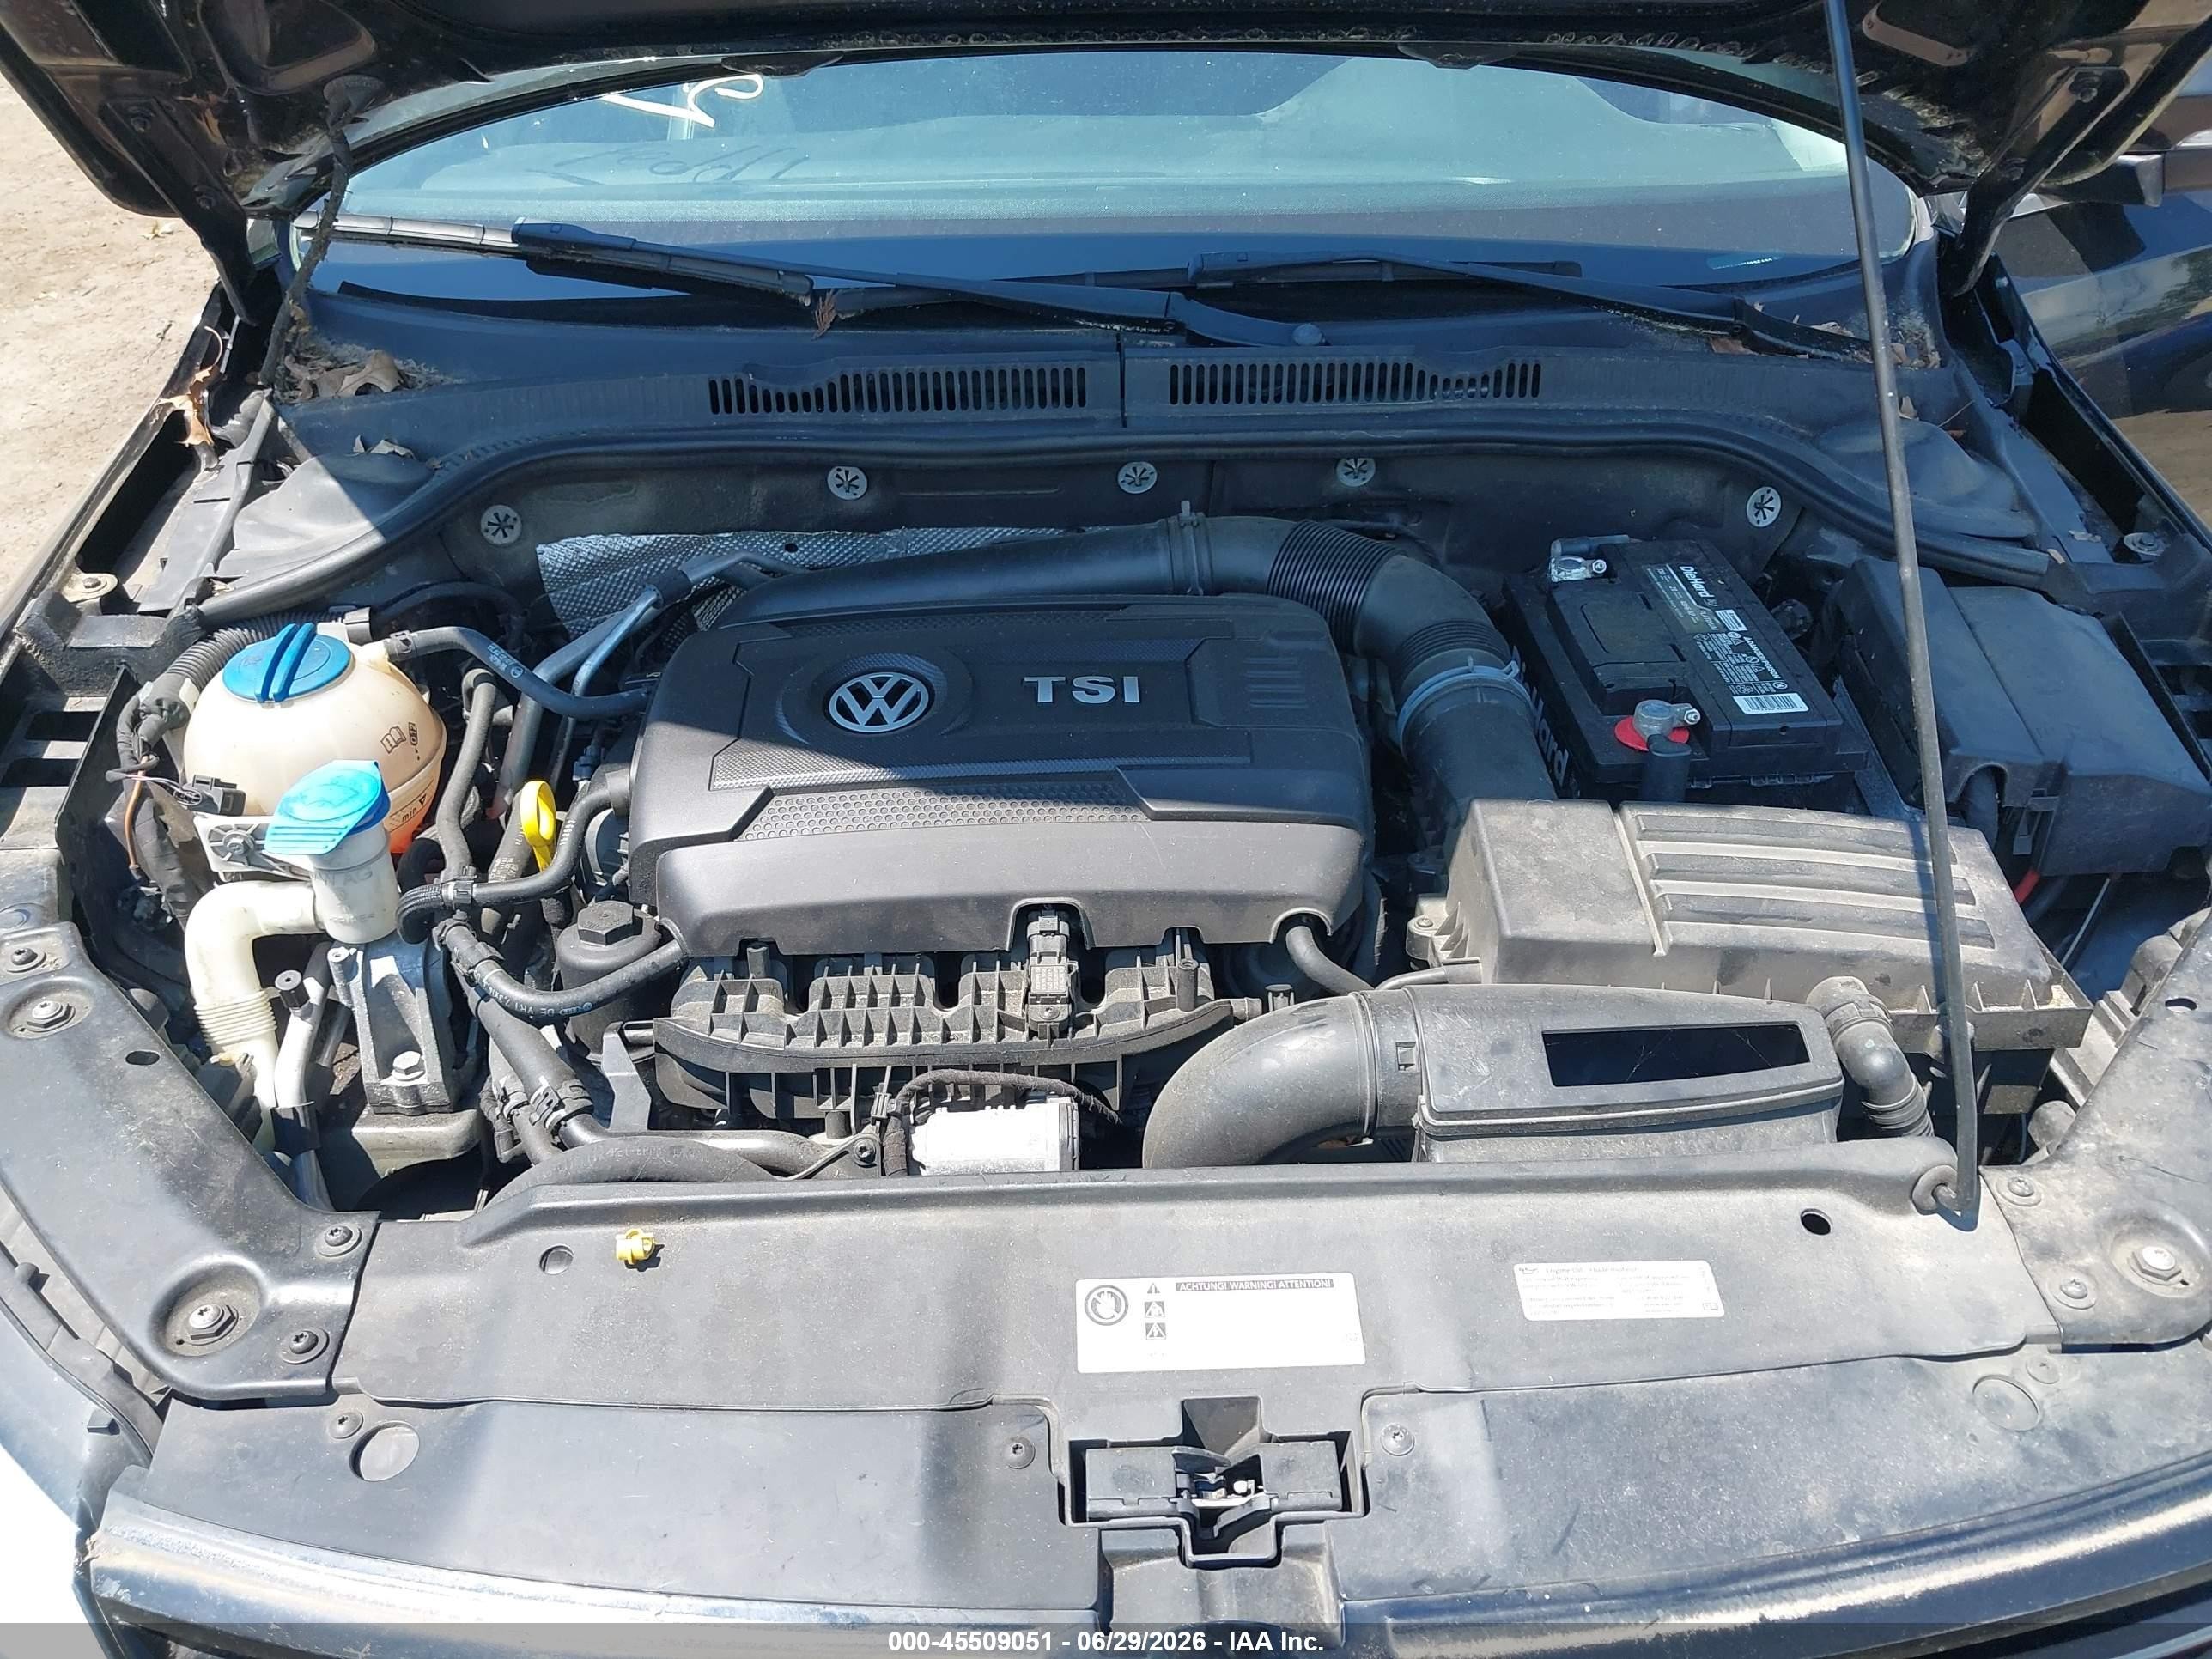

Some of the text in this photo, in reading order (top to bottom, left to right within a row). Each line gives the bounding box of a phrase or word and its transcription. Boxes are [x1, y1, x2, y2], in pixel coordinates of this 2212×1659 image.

[1679, 566, 1714, 599] DieHard
[1024, 676, 1140, 704] TSI
[402, 806, 417, 823] min
[1179, 1279, 1331, 1292] ACHTUNG! WARNING! ATTENTION!
